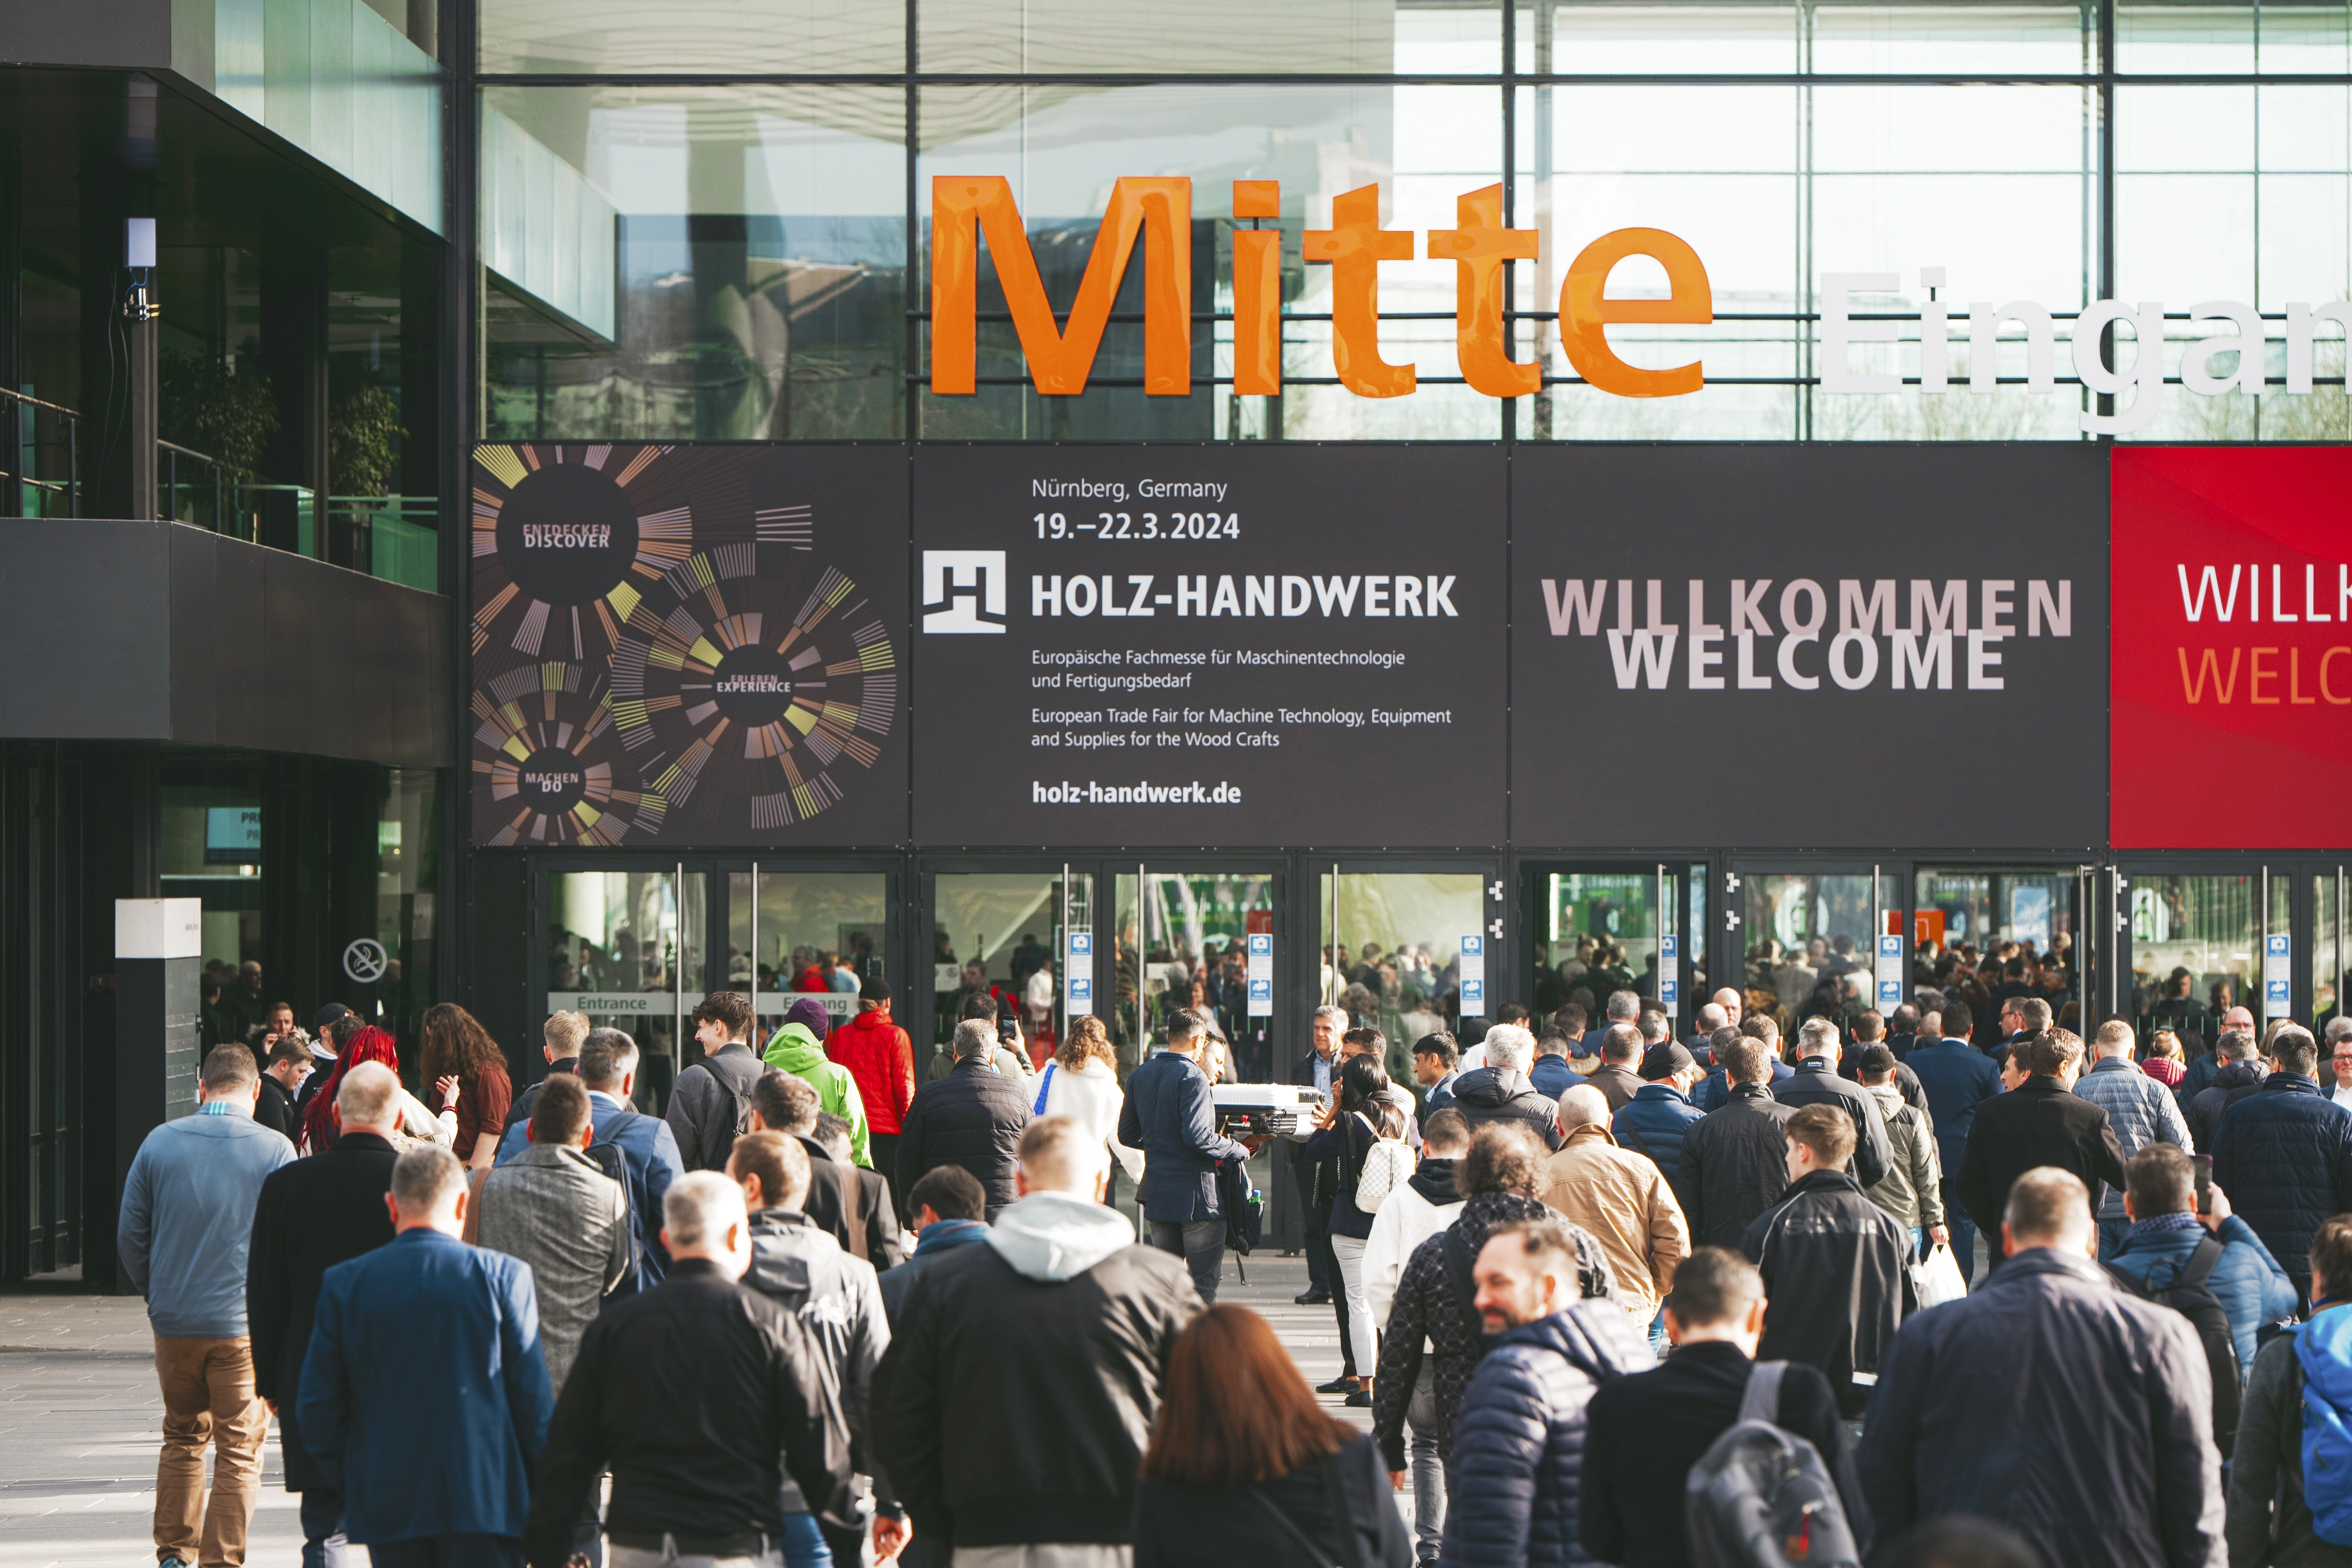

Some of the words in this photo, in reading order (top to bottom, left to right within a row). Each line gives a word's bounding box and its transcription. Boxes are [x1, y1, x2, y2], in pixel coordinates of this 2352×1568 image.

[931, 176, 1713, 398] Mitte
[1821, 267, 2352, 435] Eingan
[1033, 478, 1129, 502] Nürnberg,
[1138, 479, 1227, 502] Germany
[523, 524, 611, 536] ENTDECKEN
[525, 534, 609, 547] DISCOVER
[1032, 575, 1459, 617] HOLZ-HANDWERK
[1541, 579, 2071, 637] WILLKOMMEN
[1033, 650, 1121, 667] Europäische
[1127, 650, 1206, 664] Fachmesse
[1211, 649, 1232, 664] für
[1237, 650, 1405, 669] Maschinentechnologie
[1607, 628, 2004, 690] WELCOME
[1032, 672, 1060, 687] und
[1066, 672, 1192, 691] Fertigungsbedarf
[2178, 646, 2352, 705] WELC
[717, 682, 791, 692] EXPERIENCE
[1033, 708, 1101, 726] European
[1107, 708, 1148, 723] Trade
[1153, 708, 1178, 723] Fair
[1183, 707, 1204, 723] for
[1210, 708, 1273, 723] Machine
[1278, 708, 1365, 727] Technology,
[1372, 708, 1451, 727] Equipment
[1031, 731, 1059, 746] and
[1065, 731, 1125, 749] Supplies
[1130, 731, 1152, 746] for
[1156, 731, 1181, 746] the
[1185, 731, 1231, 746] Wood
[1236, 731, 1280, 746] Crafts
[525, 773, 579, 783] MACHEN
[542, 781, 562, 793] DO
[1033, 781, 1241, 803] holz-handwerk.de
[577, 997, 647, 1009] Entrance
